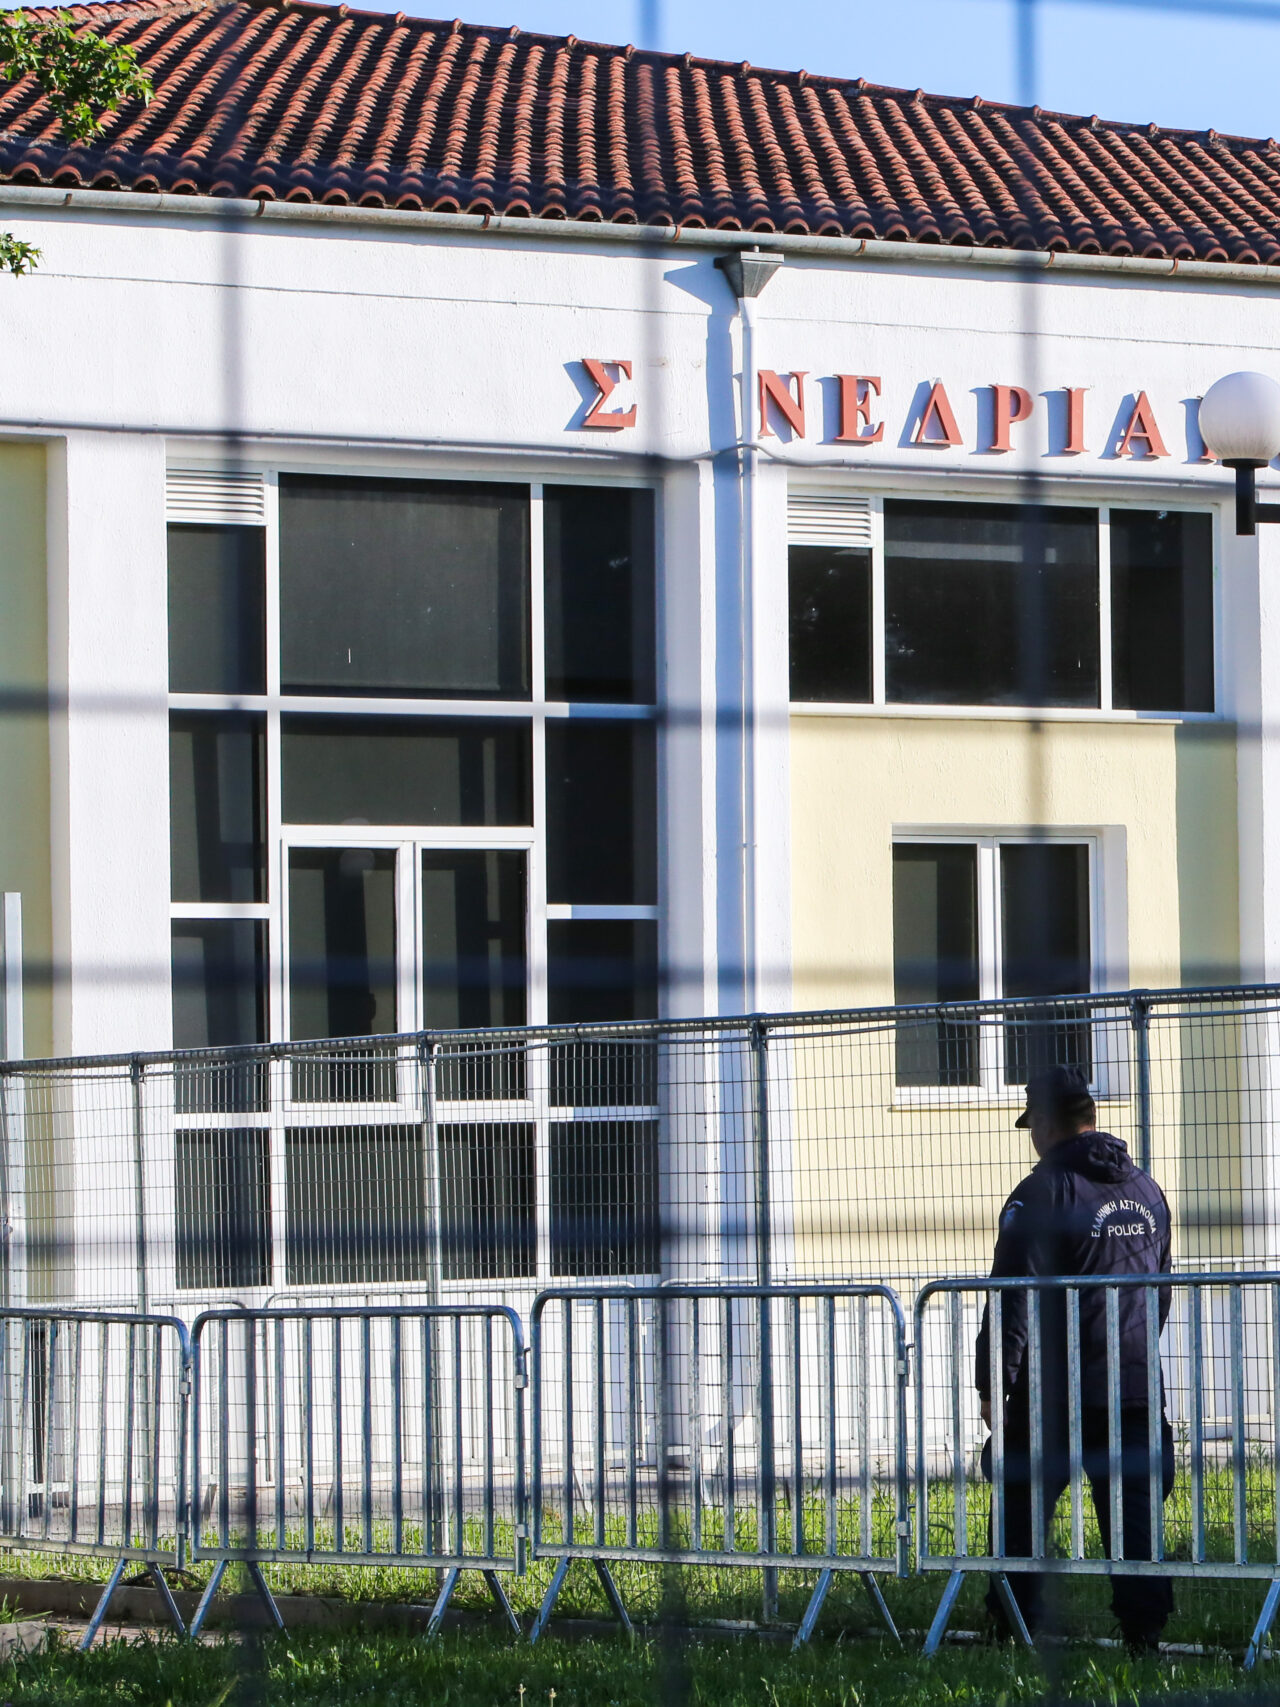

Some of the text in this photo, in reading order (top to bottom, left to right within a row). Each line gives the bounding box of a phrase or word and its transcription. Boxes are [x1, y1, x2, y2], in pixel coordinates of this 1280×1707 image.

[1091, 1199, 1157, 1238] ΕΛΛΗΝΙΚΗ ΑΣΤΥΝΟΜΙΑ
[1107, 1222, 1146, 1238] POLICE
